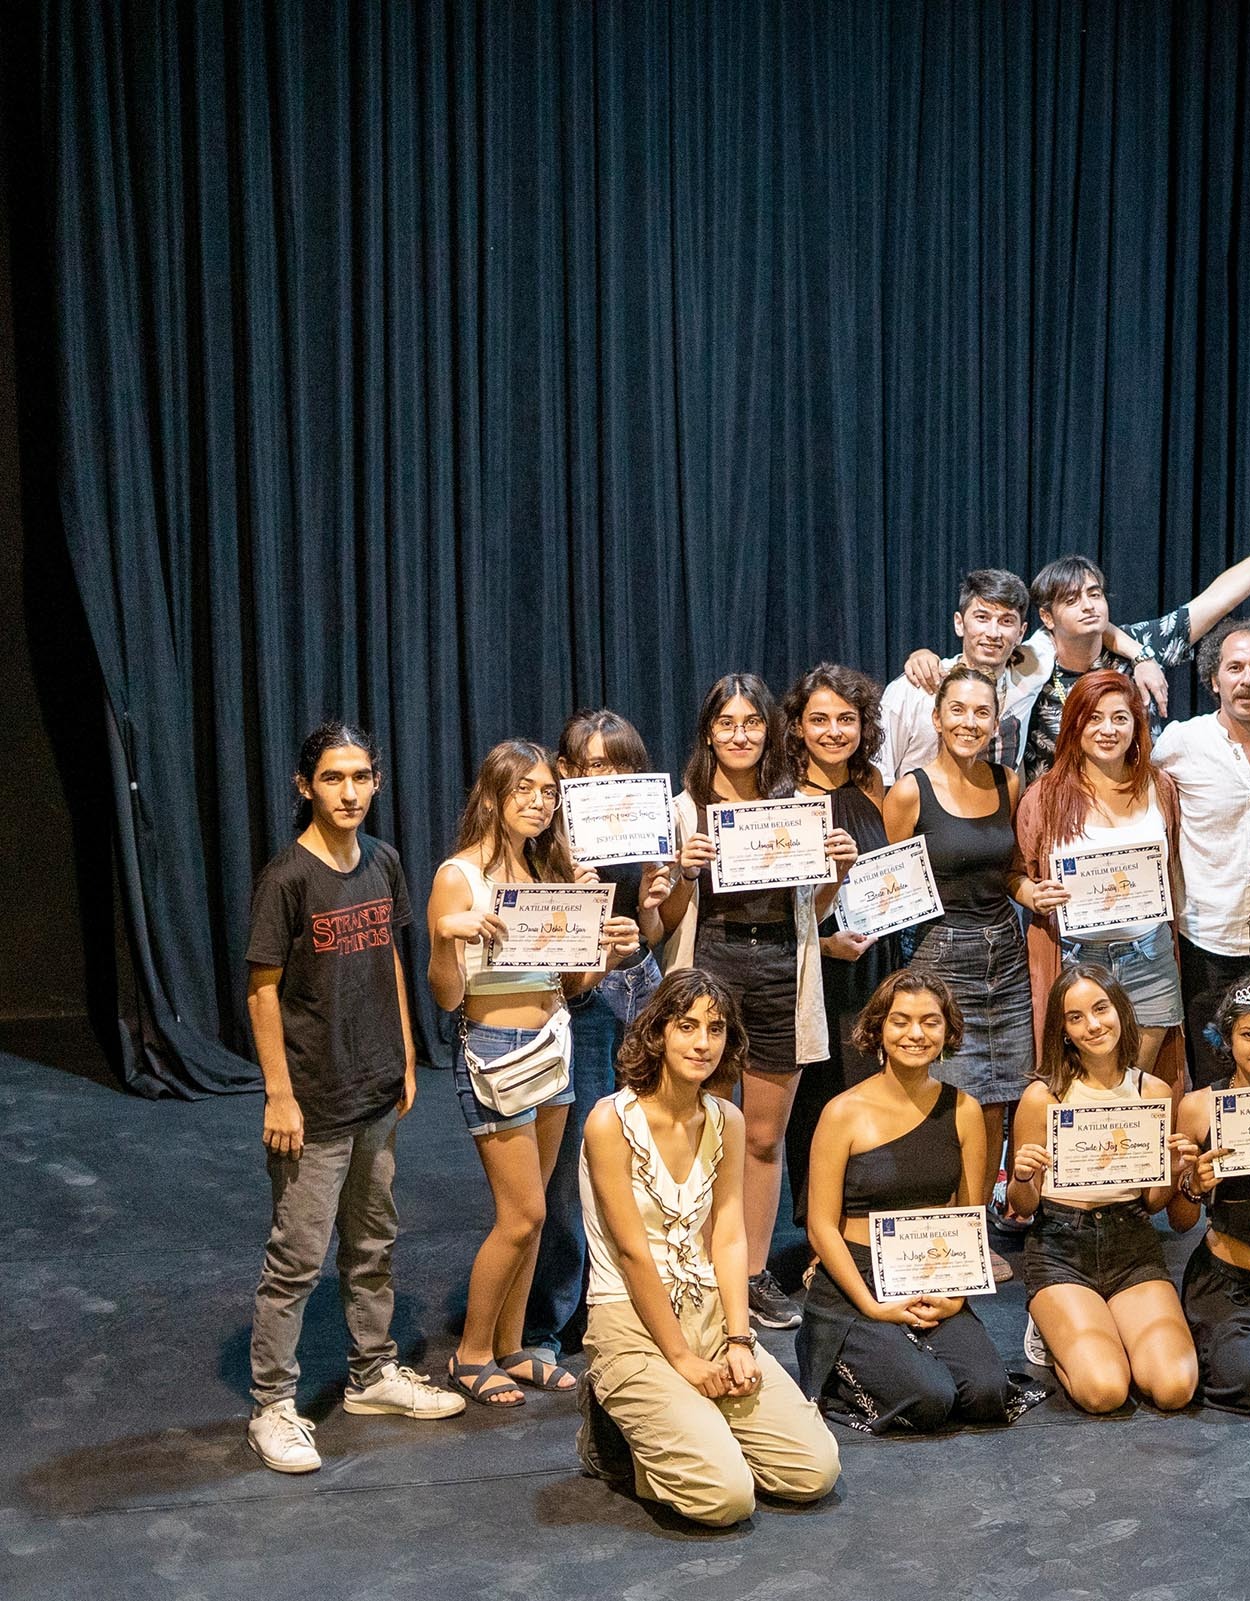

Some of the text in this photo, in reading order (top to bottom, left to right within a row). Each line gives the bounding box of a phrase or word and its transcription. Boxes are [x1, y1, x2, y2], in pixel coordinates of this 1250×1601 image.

[337, 927, 390, 955] THINGS
[1077, 1122, 1108, 1132] KATILIM
[899, 1232, 929, 1241] KATILIM
